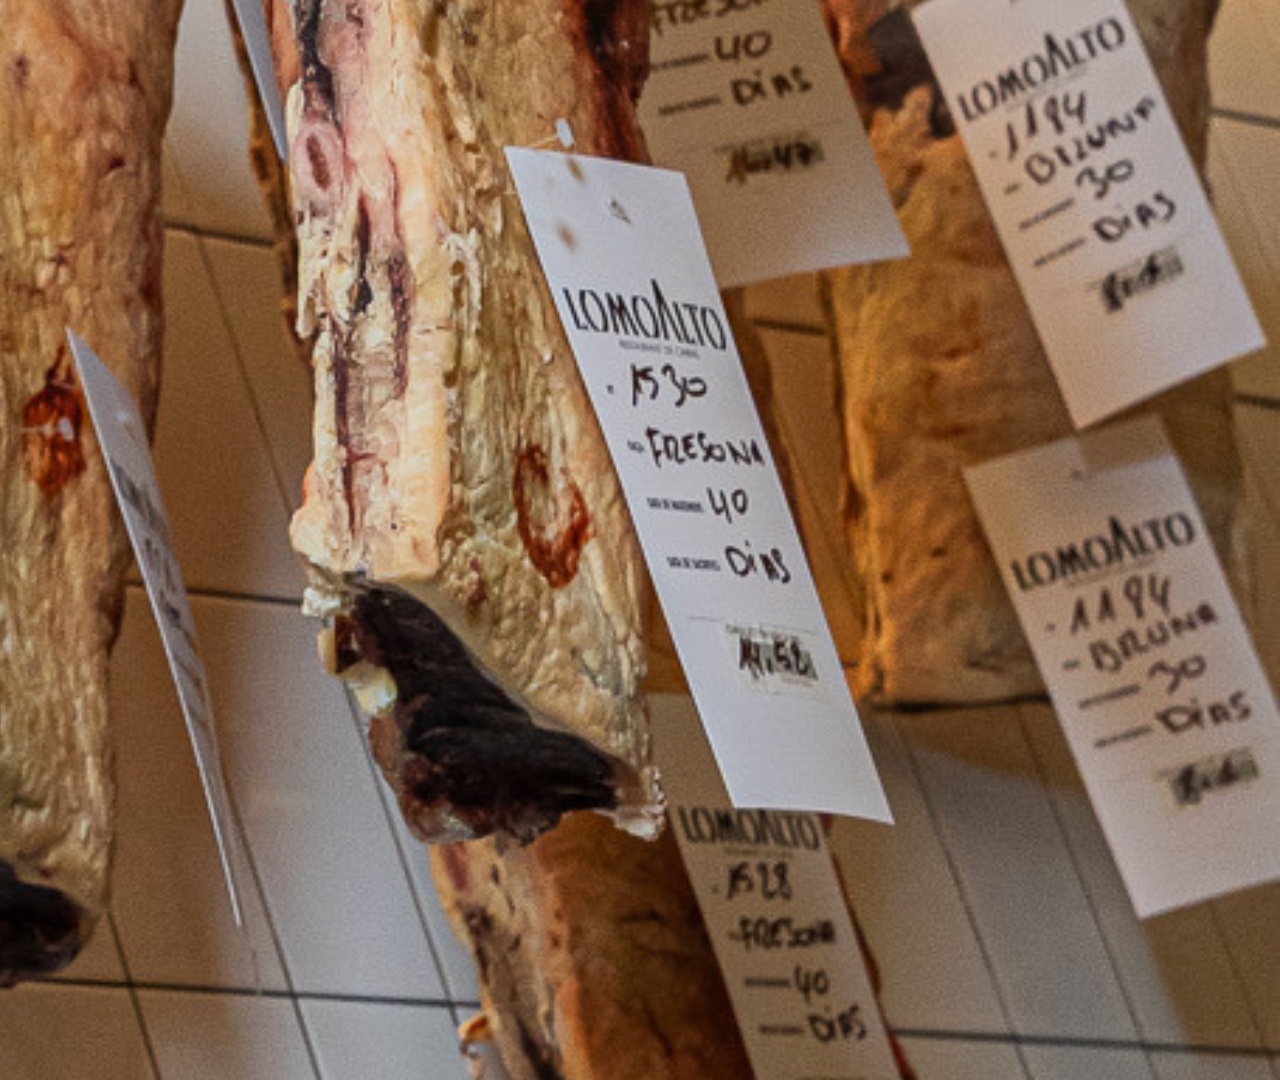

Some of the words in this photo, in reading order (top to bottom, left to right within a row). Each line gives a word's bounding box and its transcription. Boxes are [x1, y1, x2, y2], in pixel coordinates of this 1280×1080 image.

[714, 29, 772, 63] 40
[957, 17, 1126, 122] LOMOALTO
[562, 278, 727, 351] LOMOALTO
[707, 486, 749, 524] 40
[1011, 511, 1196, 592] LOMOALTO
[793, 965, 830, 1003] 40
